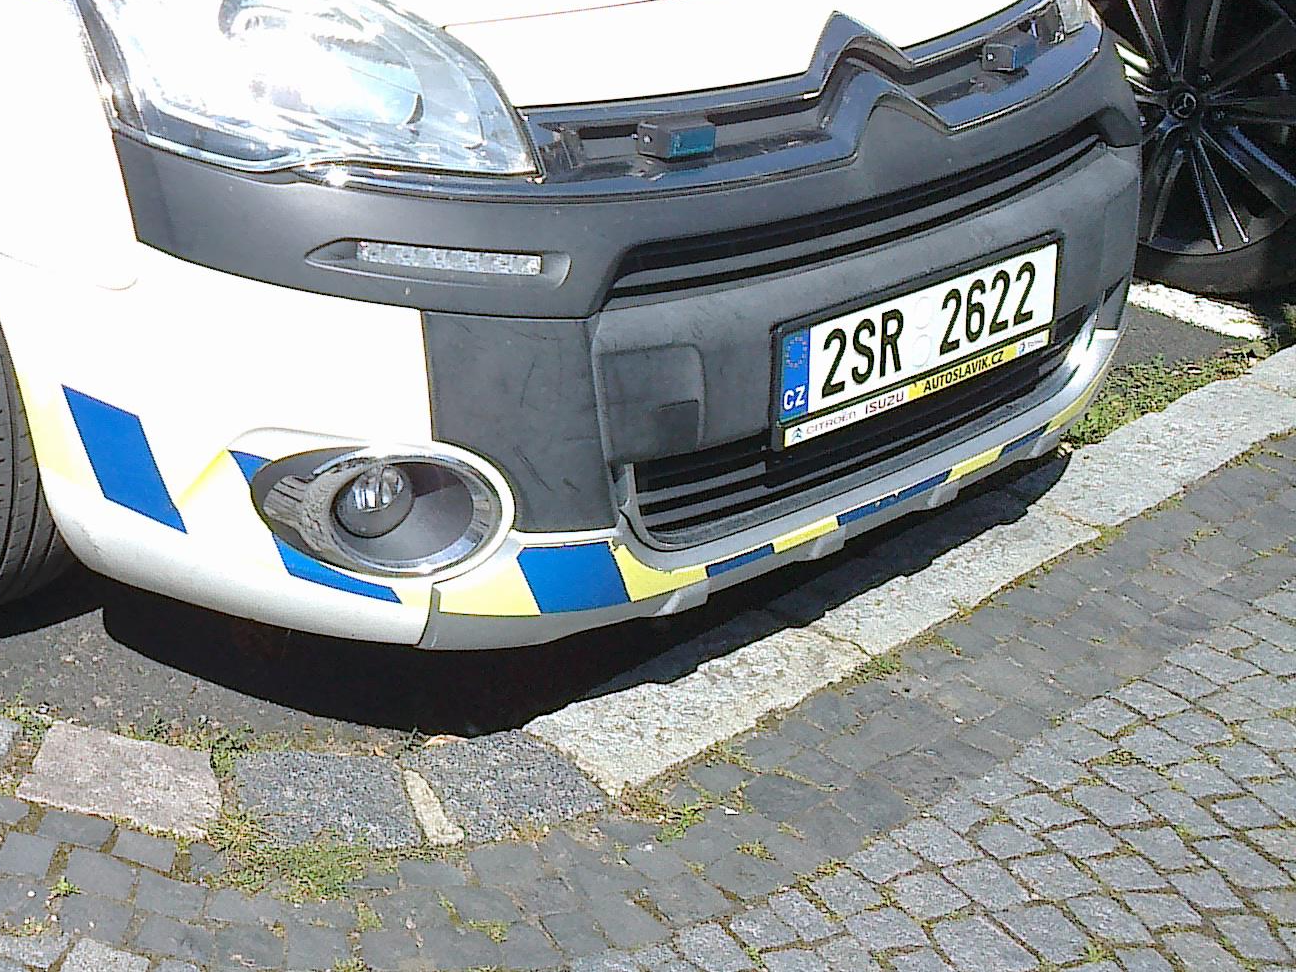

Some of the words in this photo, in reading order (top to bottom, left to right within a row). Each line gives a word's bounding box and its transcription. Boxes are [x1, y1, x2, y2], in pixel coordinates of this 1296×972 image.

[821, 308, 905, 399] 2SR
[939, 261, 1037, 357] 2622
[783, 385, 806, 411] CZ
[865, 390, 905, 415] ISUZU
